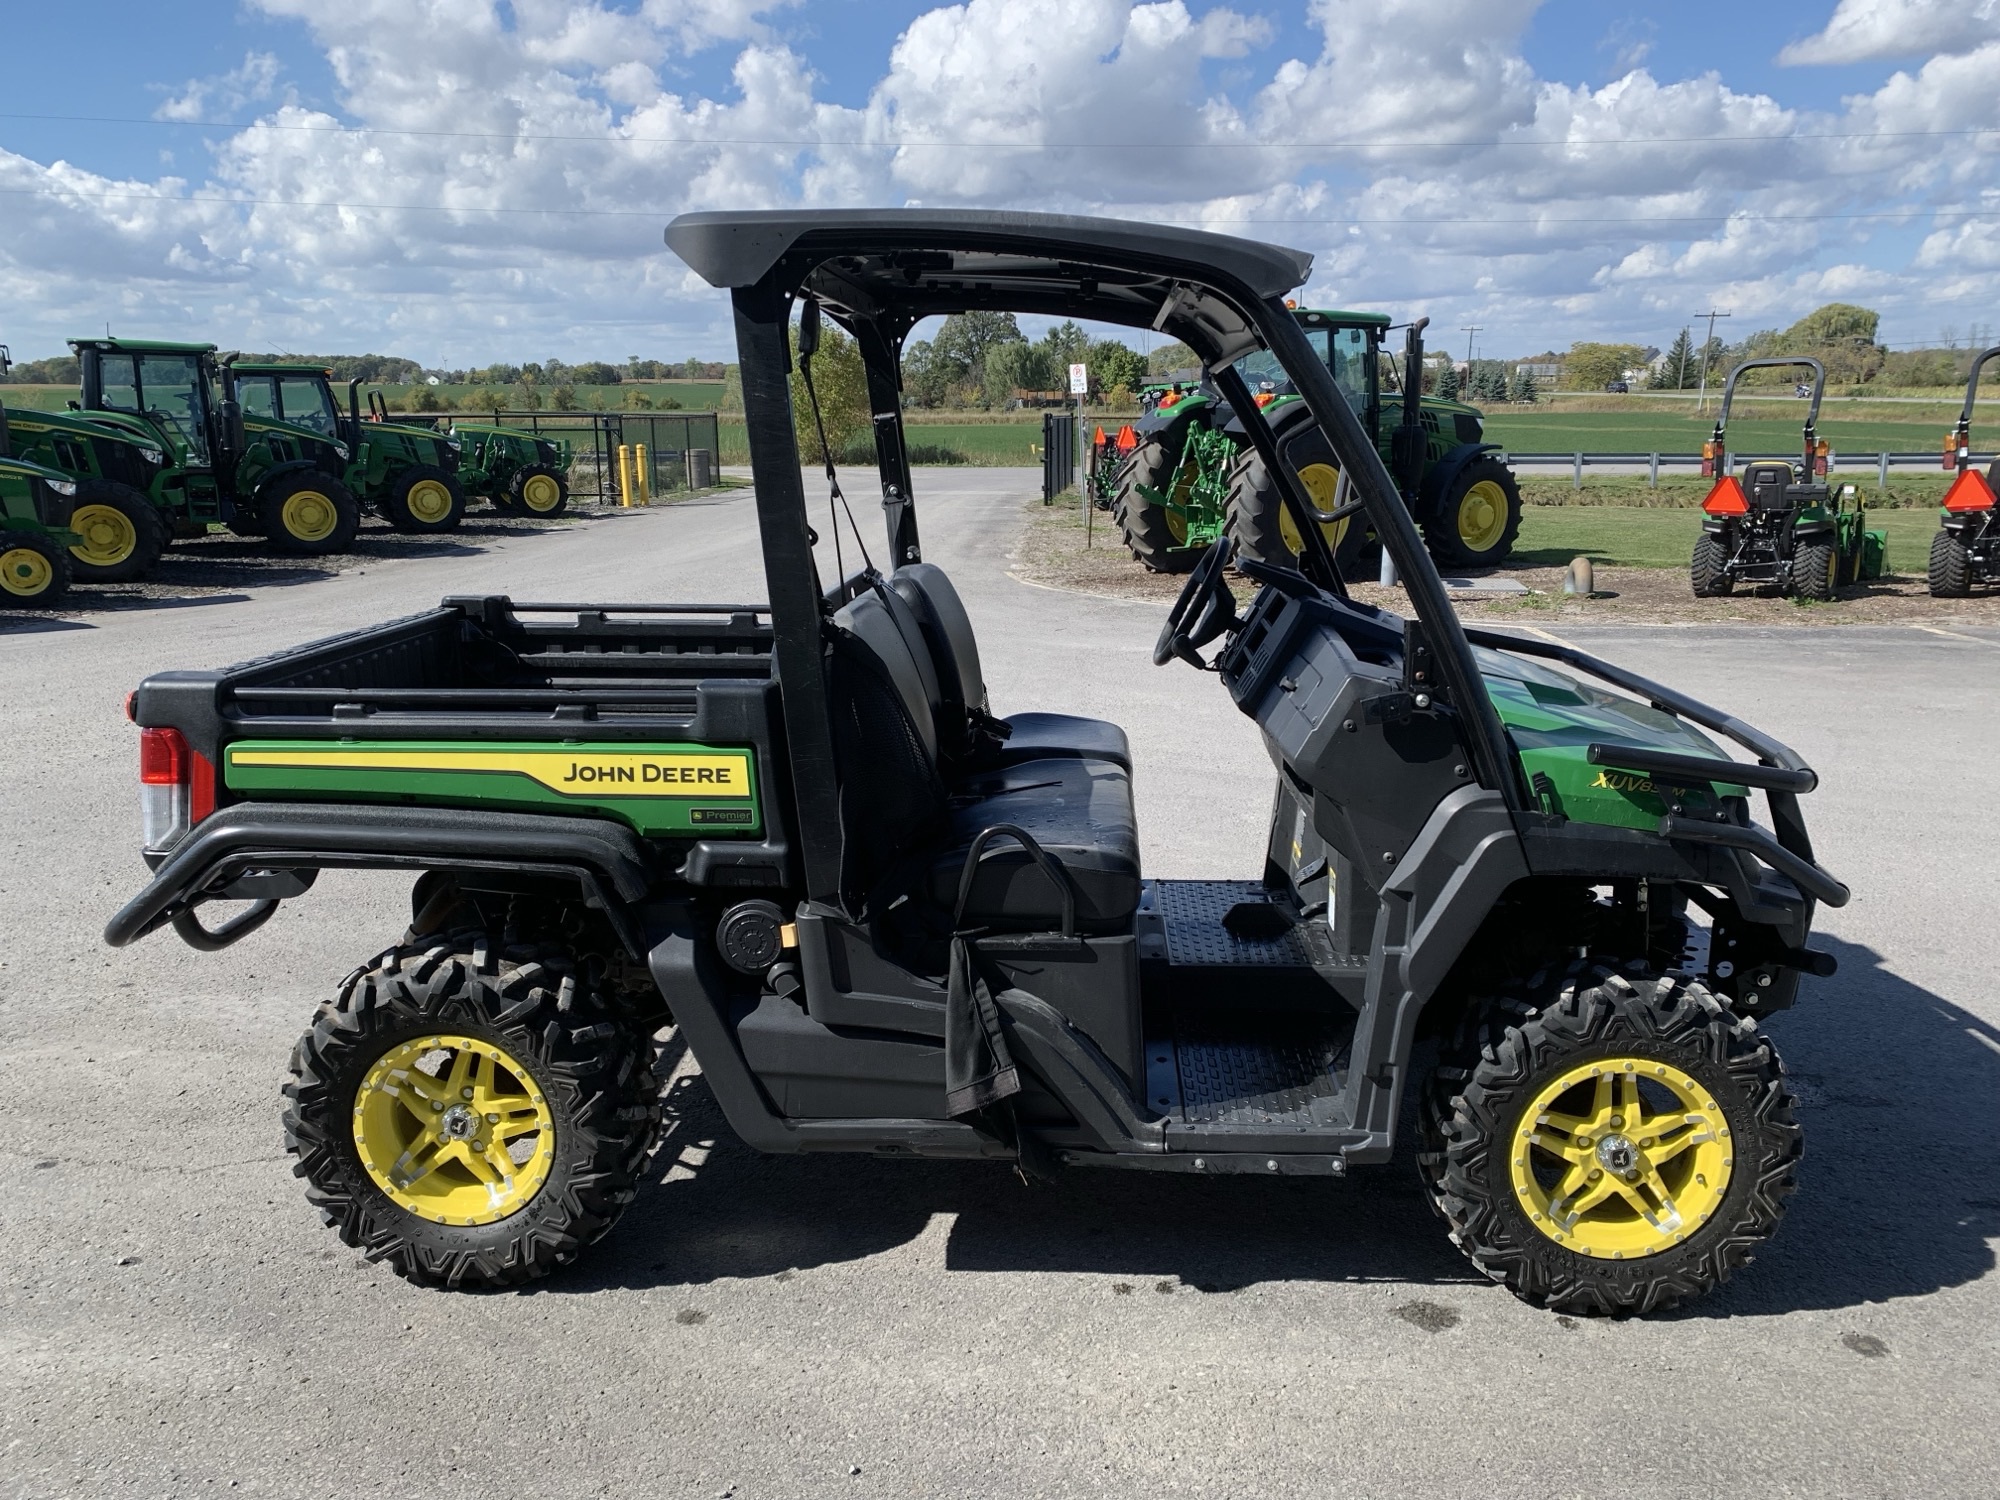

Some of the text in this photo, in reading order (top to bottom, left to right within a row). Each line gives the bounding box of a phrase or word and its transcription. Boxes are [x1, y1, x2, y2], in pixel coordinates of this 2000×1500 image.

[563, 762, 732, 784] JOHN DEERE
[706, 811, 751, 820] Premier
